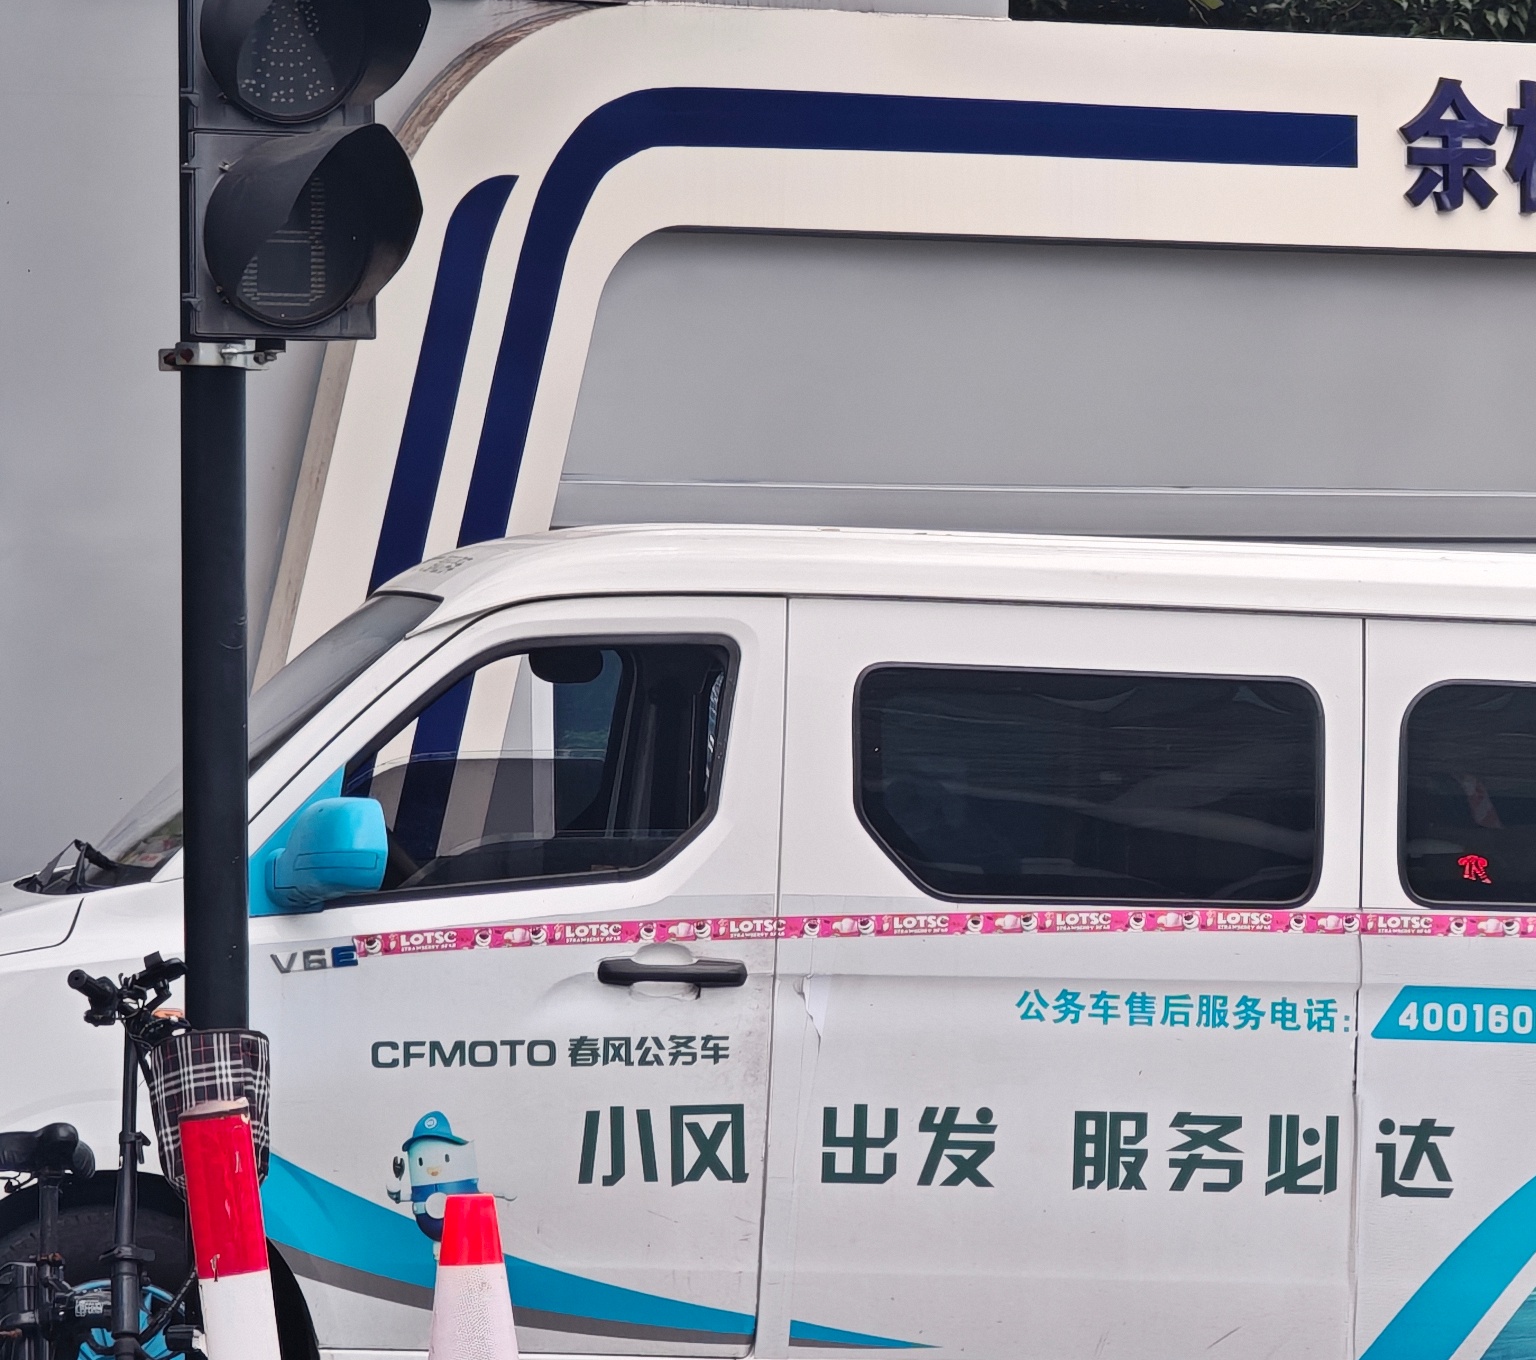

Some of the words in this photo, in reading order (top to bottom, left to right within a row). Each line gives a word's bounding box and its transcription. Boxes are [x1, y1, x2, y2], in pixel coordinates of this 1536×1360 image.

[270, 946, 359, 974] V6E
[371, 1039, 557, 1069] CFMOTO
[567, 1035, 730, 1067] 春风公务车
[578, 1103, 749, 1187] 小风
[821, 1104, 998, 1187] 出发
[1072, 1110, 1455, 1199] 服务必达
